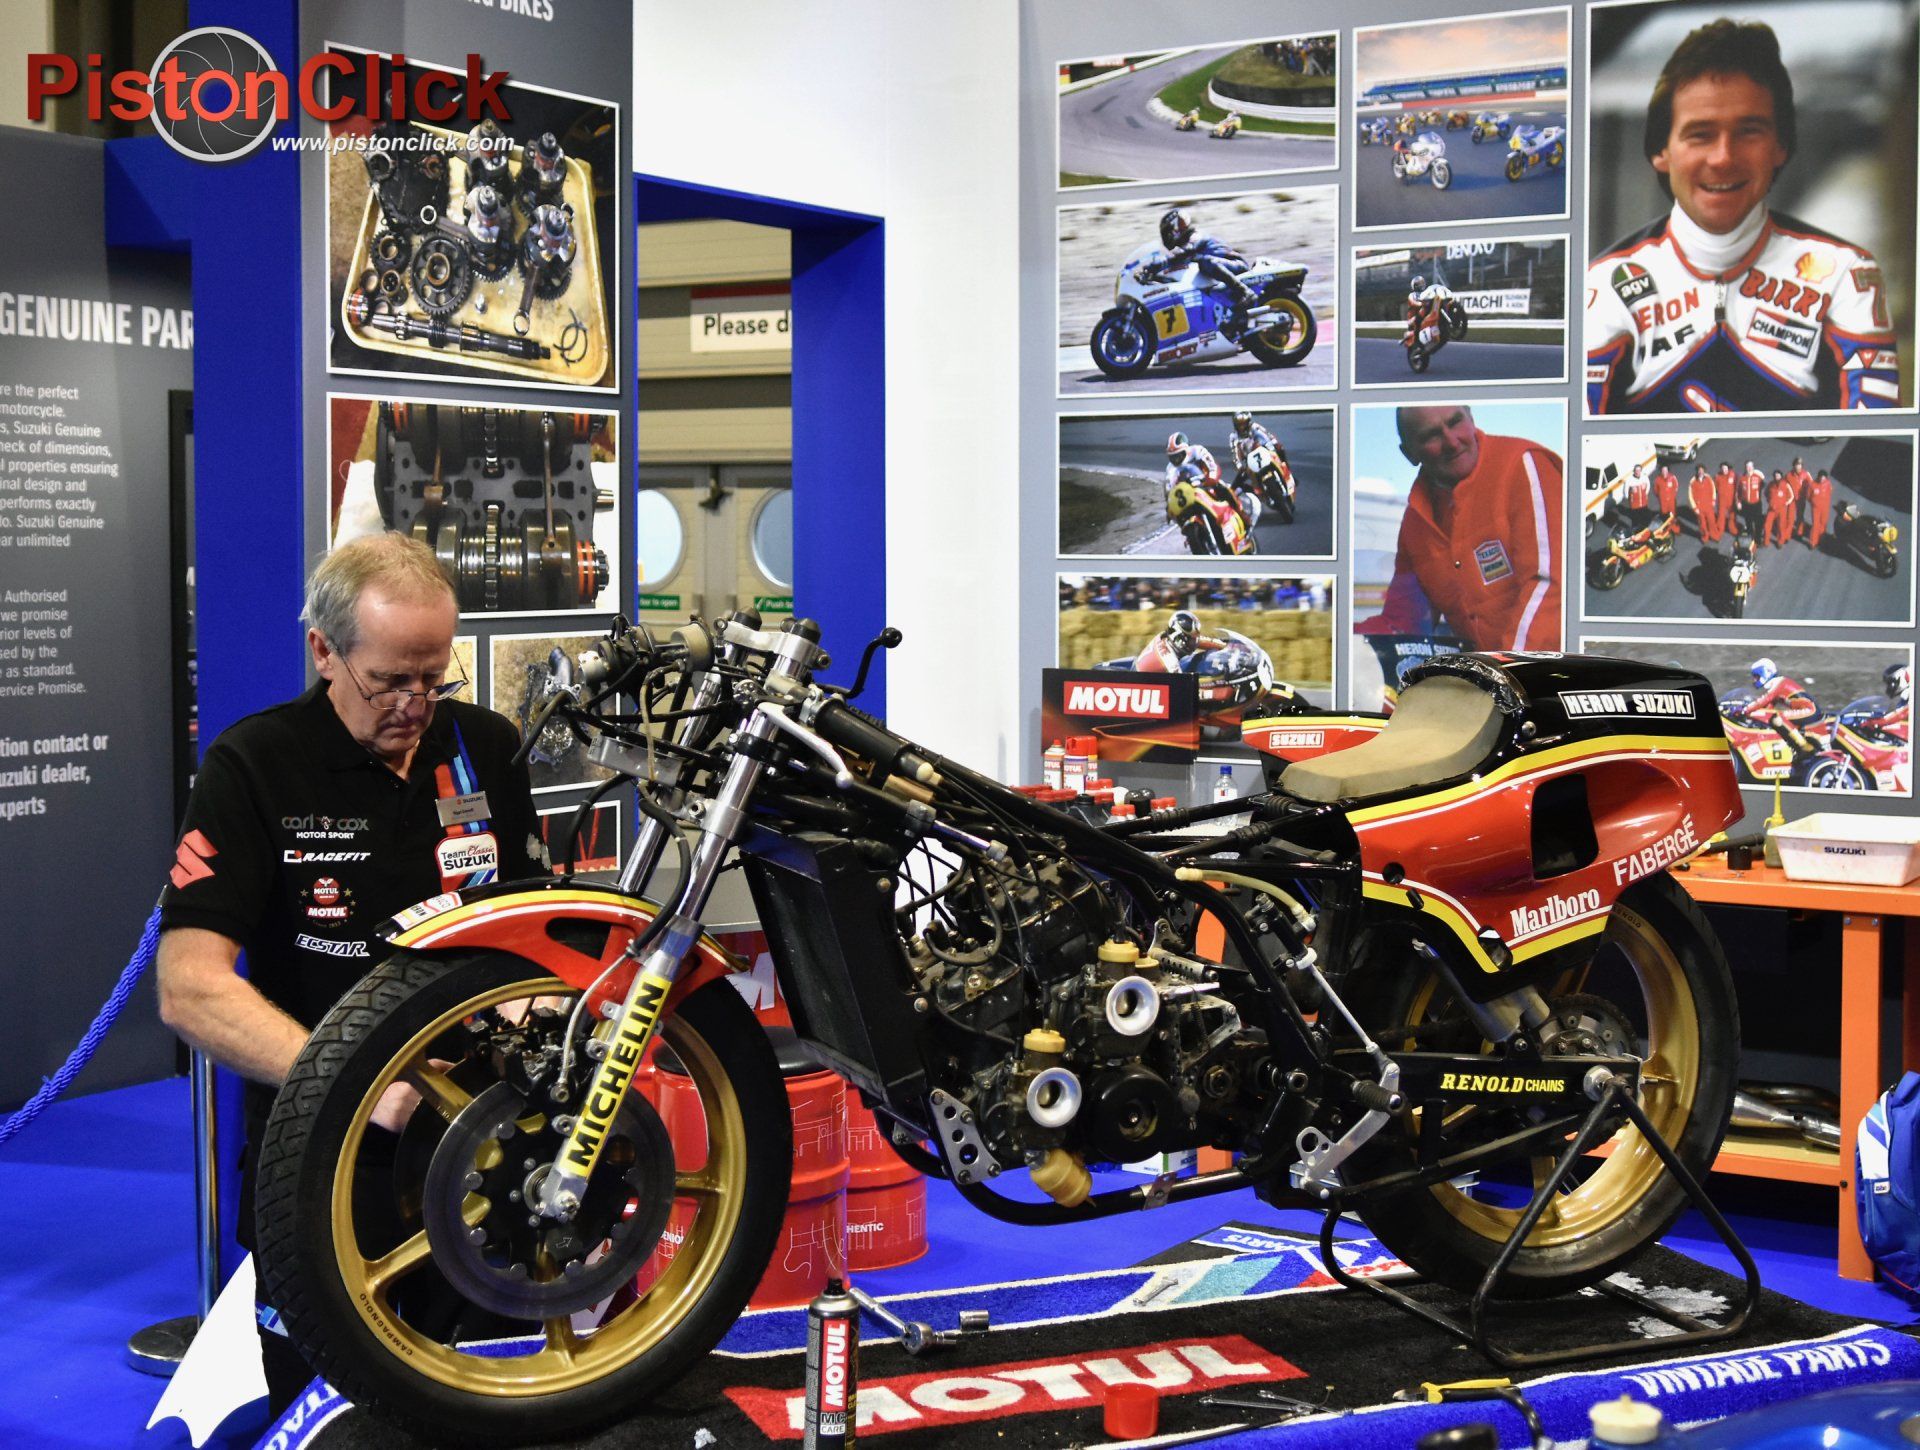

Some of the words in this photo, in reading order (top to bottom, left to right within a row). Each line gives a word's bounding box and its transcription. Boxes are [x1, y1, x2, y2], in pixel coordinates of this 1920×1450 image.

[1621, 278, 1650, 298] agv
[0, 291, 132, 345] GENUINE
[704, 313, 768, 336] Please
[777, 309, 792, 333] d
[1162, 308, 1175, 333] 7
[1753, 319, 1811, 348] CHAMPION
[15, 384, 34, 397] the
[38, 385, 79, 400] perfect
[13, 420, 52, 435] Suzuki
[55, 423, 102, 437] Genuine
[29, 440, 42, 453] of
[45, 441, 112, 458] dimensions,
[8, 459, 67, 474] properties
[70, 462, 120, 477] ensuring
[24, 477, 62, 494] design
[65, 479, 88, 492] and
[55, 497, 96, 512] exactly
[16, 514, 54, 528] Suzuki
[57, 515, 105, 529] Genuine
[17, 533, 71, 548] unlimited
[4, 589, 67, 603] Authorised
[21, 608, 67, 624] promise
[23, 626, 55, 640] levels
[60, 626, 72, 638] of
[21, 645, 35, 660] by
[39, 645, 58, 658] the
[6, 667, 19, 678] as
[23, 663, 76, 677] standard.
[38, 681, 87, 695] Promise.
[1068, 686, 1165, 714] MOTUL
[1563, 694, 1629, 715] HERON
[1636, 694, 1692, 715] SUZUKI
[33, 733, 89, 755] contact
[93, 735, 109, 751] or
[1271, 732, 1322, 746] SUZUKI
[1771, 742, 1784, 760] 6
[41, 762, 91, 784] dealer,
[336, 817, 370, 831] cox
[296, 831, 327, 839] MOTOR
[328, 831, 354, 839] SPORT
[302, 852, 371, 862] RACEFIT
[441, 849, 467, 861] Team
[467, 845, 495, 857] Classic
[1613, 814, 1698, 886] FABERGÉ
[1824, 846, 1867, 857] SUZUKI
[443, 852, 496, 871] SUZUKI
[307, 907, 347, 917] MOTUL
[1510, 888, 1601, 937] Marlboro
[295, 933, 371, 957] ECSTAR
[567, 981, 665, 1169] MICHELIN
[1440, 1073, 1525, 1093] RENOLD
[1525, 1079, 1565, 1092] CHAINS
[359, 1293, 413, 1356] CAMPAGNOLO
[825, 1323, 846, 1407] MOTUL
[1621, 1356, 1783, 1399] VINTAGE
[1773, 1338, 1891, 1375] PARTS
[785, 1344, 1271, 1429] MOTUL
[821, 1412, 846, 1424] MC
[821, 1425, 844, 1434] CARE
